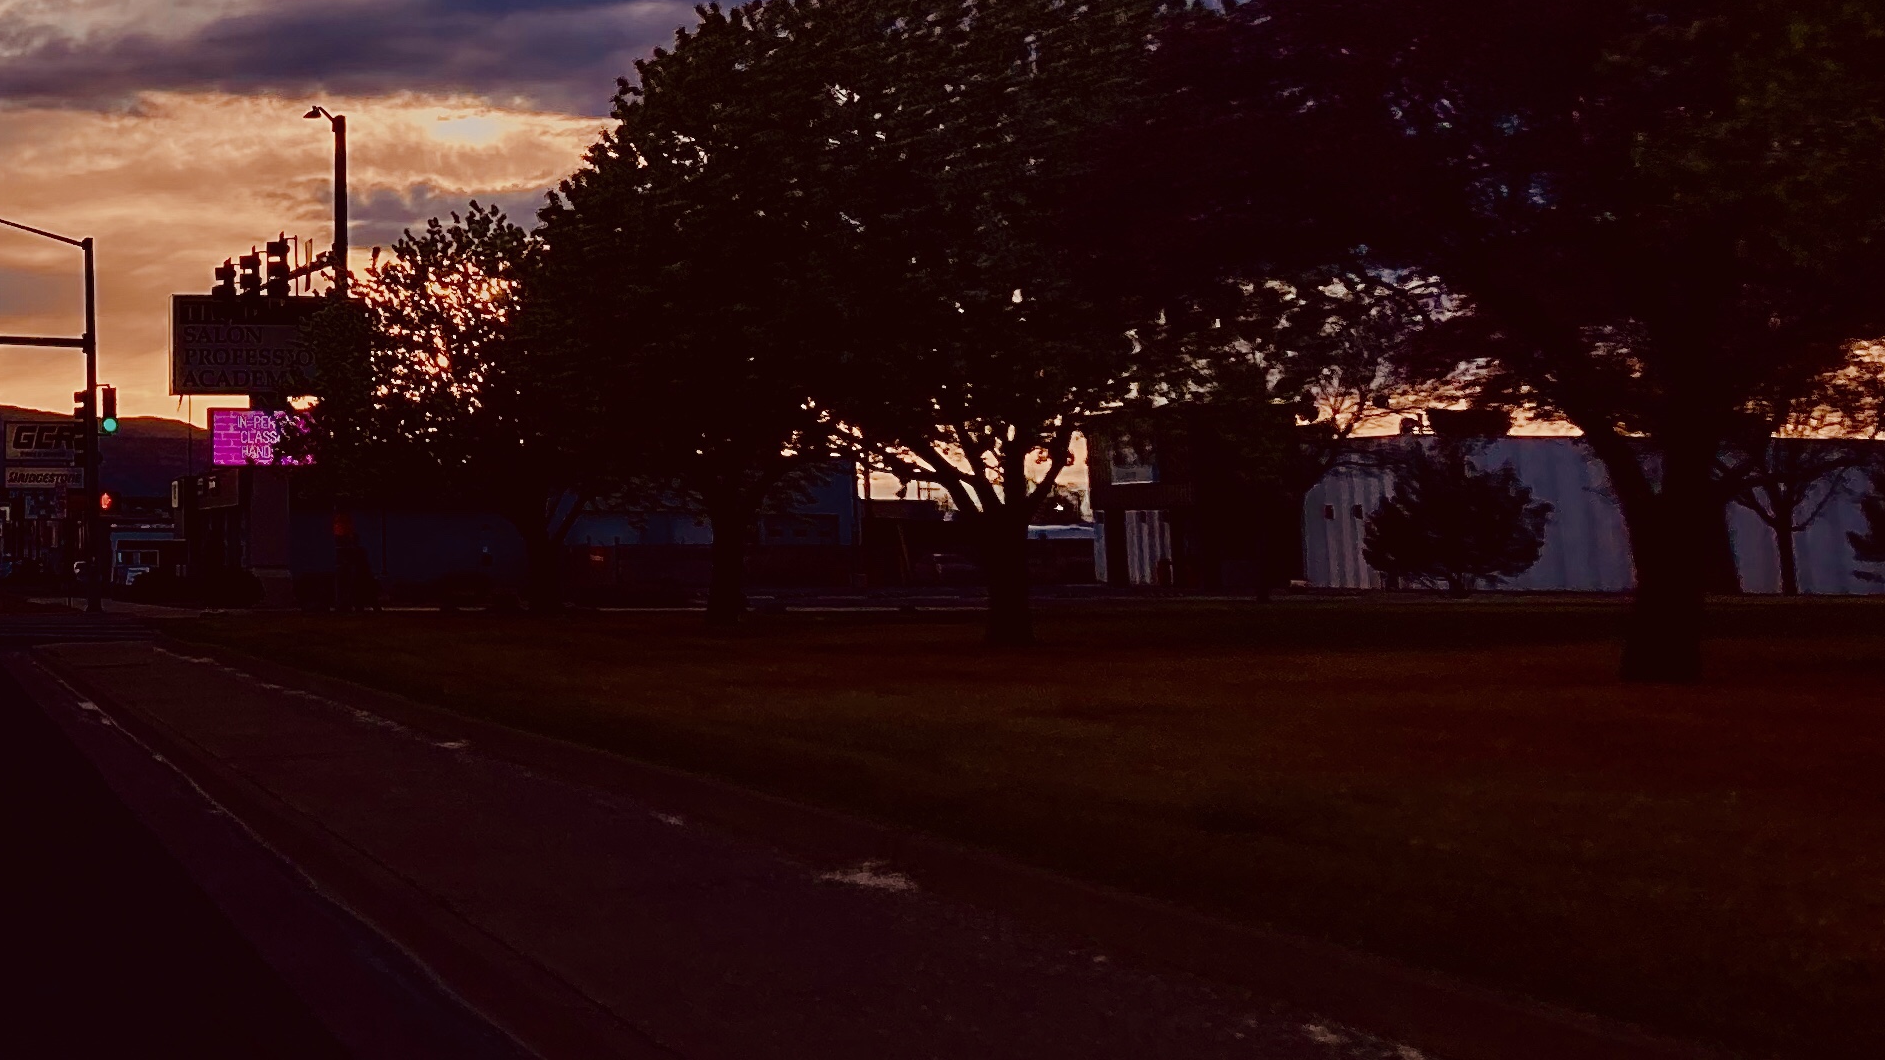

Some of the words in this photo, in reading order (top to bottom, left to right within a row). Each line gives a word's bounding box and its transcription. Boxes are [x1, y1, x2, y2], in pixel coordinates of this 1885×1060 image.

[183, 326, 264, 344] SALON
[184, 348, 315, 366] PROFESSIO
[183, 370, 288, 387] ACADEM
[237, 416, 277, 429] IN-PER
[240, 431, 280, 444] CLASS
[241, 445, 274, 459] HAND
[7, 471, 82, 483] BRIDGESTONE
